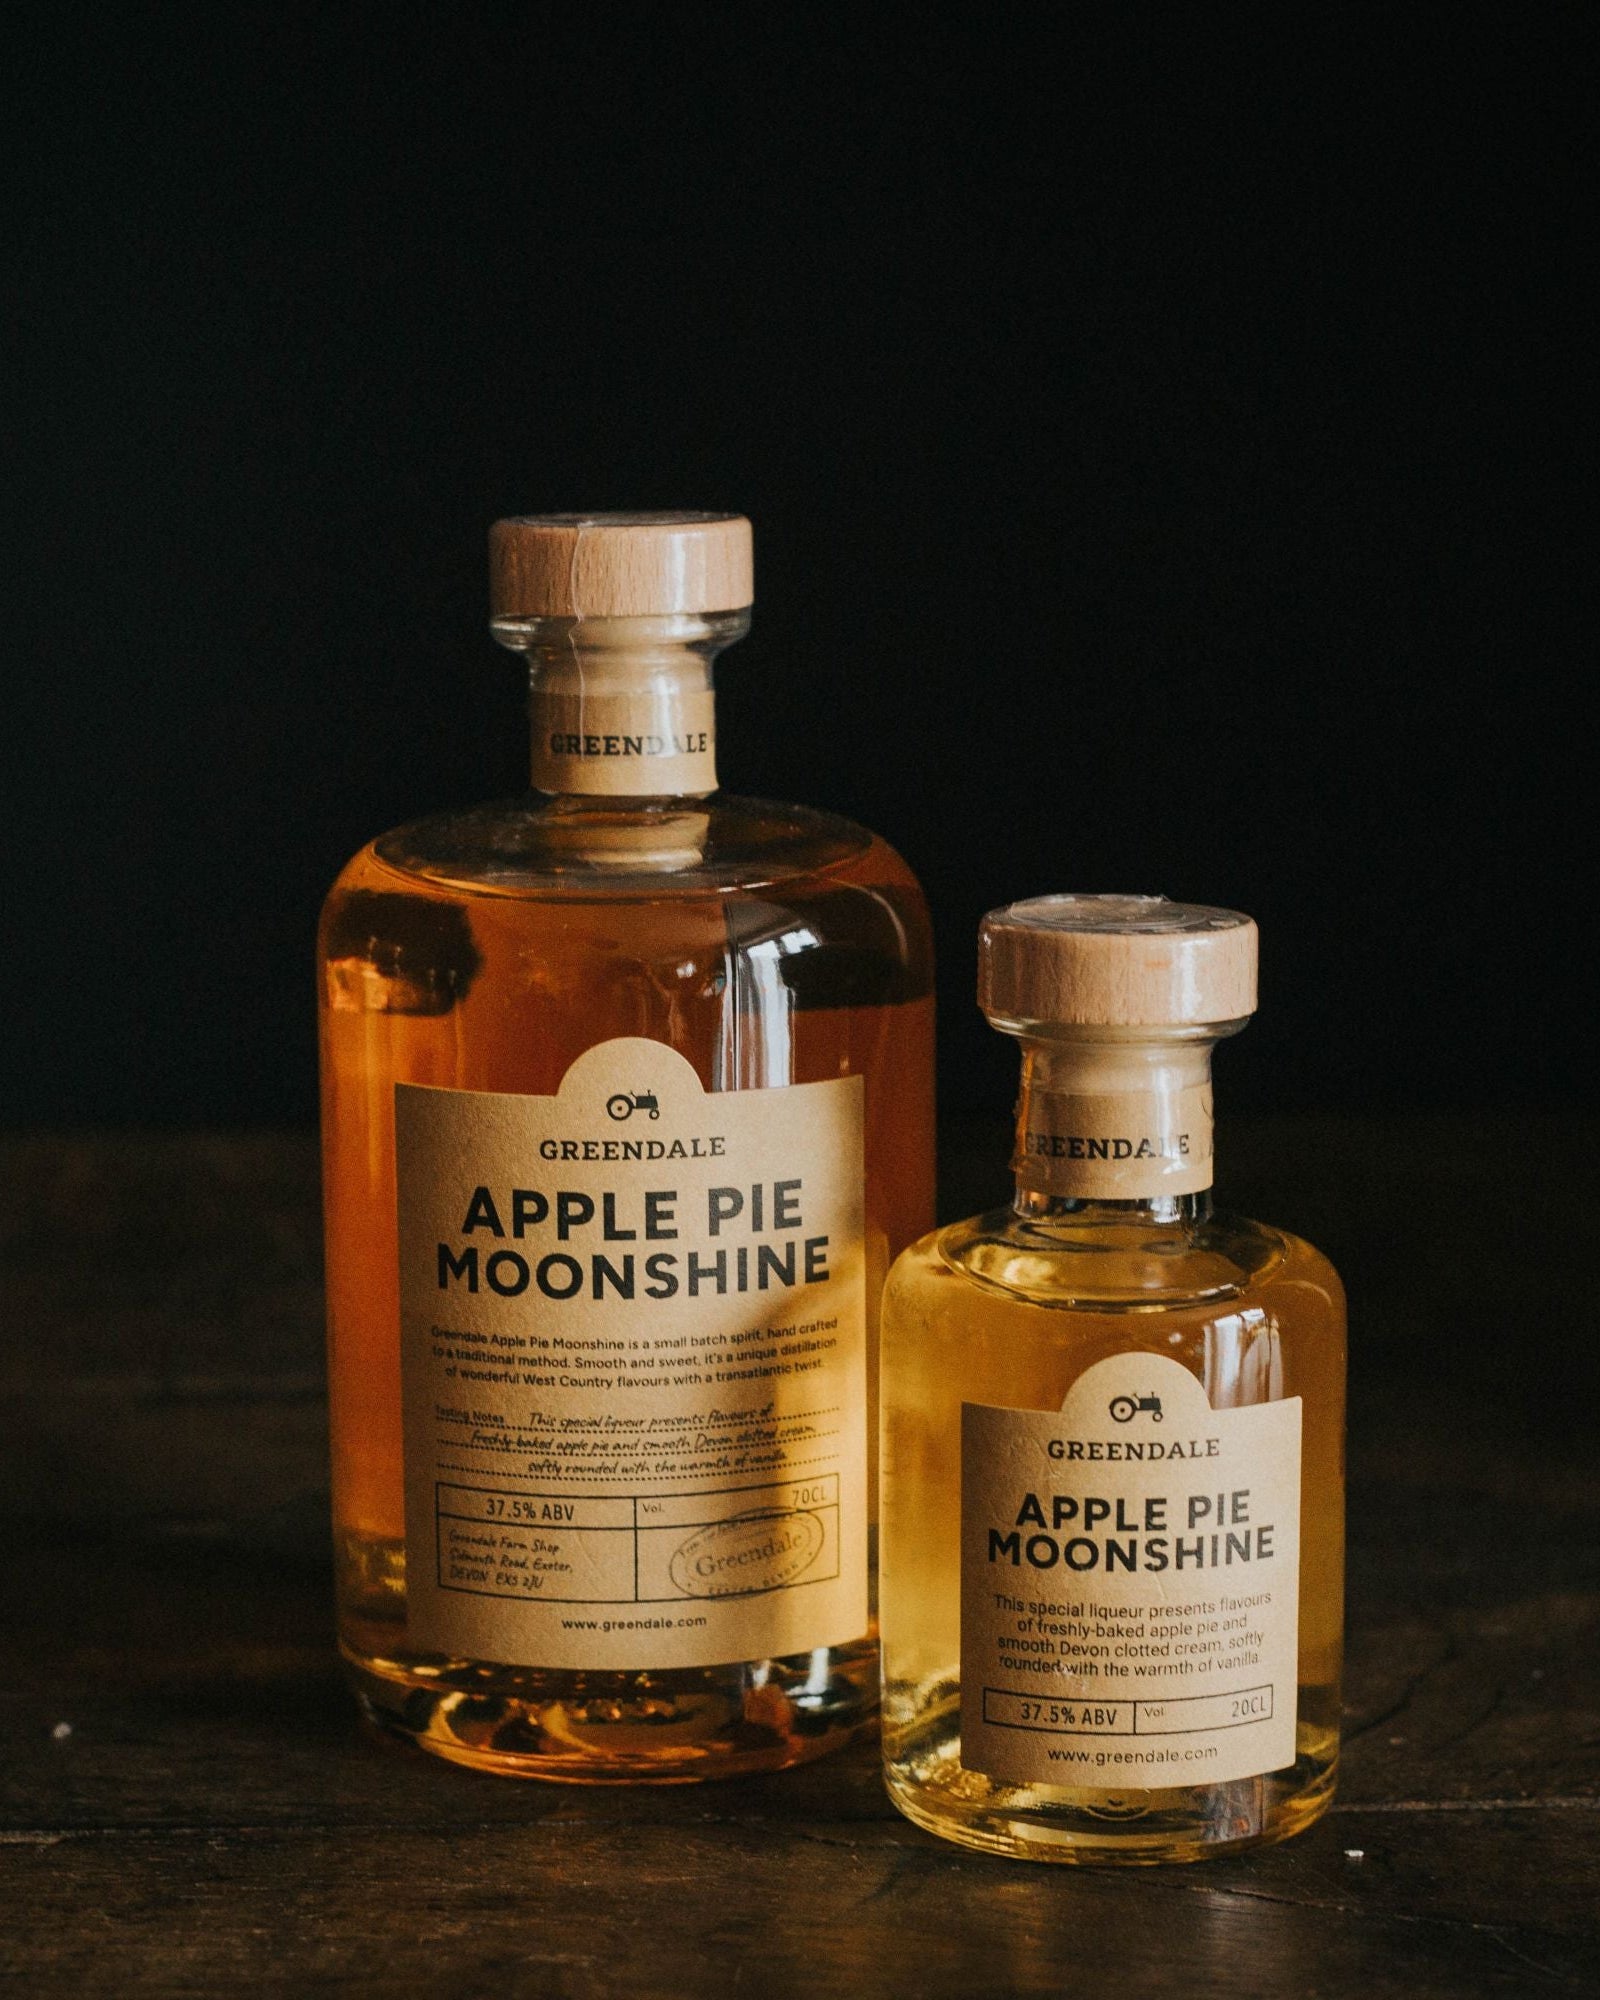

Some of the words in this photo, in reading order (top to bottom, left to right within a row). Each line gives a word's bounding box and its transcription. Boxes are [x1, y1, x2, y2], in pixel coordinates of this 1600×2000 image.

[539, 1137, 726, 1161] GREENDALE
[1027, 1134, 1189, 1159] REENDAE
[461, 1185, 679, 1241] APPLE
[708, 1179, 803, 1236] PIE
[437, 1236, 830, 1300] MOONSHINE
[431, 1324, 487, 1344] Greendale
[490, 1334, 526, 1348] Apple
[530, 1336, 549, 1349] Pie
[553, 1338, 625, 1350] Moonshine
[628, 1339, 639, 1350] is
[642, 1341, 650, 1350] a
[654, 1337, 687, 1350] small
[691, 1333, 727, 1348] batch
[767, 1327, 796, 1340] hand
[799, 1317, 837, 1335] crafted
[433, 1345, 444, 1357] to
[447, 1349, 453, 1358] a
[456, 1349, 515, 1365] traditional
[518, 1355, 571, 1369] method.
[575, 1357, 627, 1369] Smooth
[631, 1357, 654, 1369] and
[705, 1352, 723, 1365] it's
[726, 1354, 733, 1363] a
[736, 1348, 777, 1365] unique
[780, 1337, 837, 1356] distillation
[445, 1366, 456, 1377] of
[460, 1368, 520, 1384] wonderful
[523, 1373, 556, 1386] West
[559, 1375, 613, 1390] Country
[617, 1376, 670, 1389] flavours
[674, 1373, 701, 1387] with
[705, 1374, 712, 1383] a
[716, 1362, 792, 1382] transatlantic
[436, 1405, 469, 1421] Tasting
[472, 1410, 504, 1424] Notes
[529, 1412, 556, 1427] This
[560, 1416, 602, 1432] special
[649, 1415, 705, 1431] presents
[707, 1408, 755, 1425] flavours
[556, 1439, 588, 1456] apple
[592, 1440, 609, 1456] pie
[612, 1438, 638, 1451] and
[643, 1436, 691, 1449] smooth
[694, 1432, 733, 1450] Devon
[1048, 1439, 1220, 1461] GREENDALE
[528, 1459, 562, 1477] softly
[565, 1461, 617, 1475] rounded
[621, 1461, 649, 1474] with
[655, 1460, 676, 1473] the
[680, 1454, 730, 1472] warmth
[734, 1453, 749, 1468] of
[792, 1485, 827, 1506] 70CL
[486, 1498, 536, 1519] 37.5%
[541, 1503, 575, 1522] ABV
[1015, 1492, 1167, 1532] APPLE
[1188, 1489, 1250, 1529] PIE
[501, 1536, 528, 1551] Farm
[531, 1538, 560, 1556] Shop
[988, 1525, 1274, 1572] MOONSHINE
[993, 1594, 1025, 1612] This
[1029, 1600, 1084, 1618] special
[1089, 1603, 1143, 1621] liqueur
[1149, 1601, 1215, 1620] presents
[1219, 1591, 1272, 1612] flavours
[561, 1616, 707, 1632] www.greendale.com
[1017, 1617, 1033, 1632] of
[1036, 1618, 1145, 1640] freshly-baked
[1150, 1622, 1193, 1639] apple
[1197, 1620, 1219, 1637] pie
[1222, 1613, 1247, 1631] and
[997, 1635, 1055, 1654] smooth
[1060, 1640, 1110, 1657] Devon
[1114, 1642, 1170, 1658] clotted
[1228, 1630, 1264, 1650] softly
[999, 1655, 1062, 1673] rounded
[1066, 1660, 1099, 1676] with
[1104, 1662, 1129, 1677] the
[1133, 1660, 1193, 1676] warmth
[1198, 1656, 1212, 1673] of
[1020, 1702, 1076, 1725] 37.5%
[1081, 1707, 1118, 1726] ABV
[1231, 1695, 1267, 1718] 20CL
[1047, 1746, 1218, 1766] www.greendale.com
